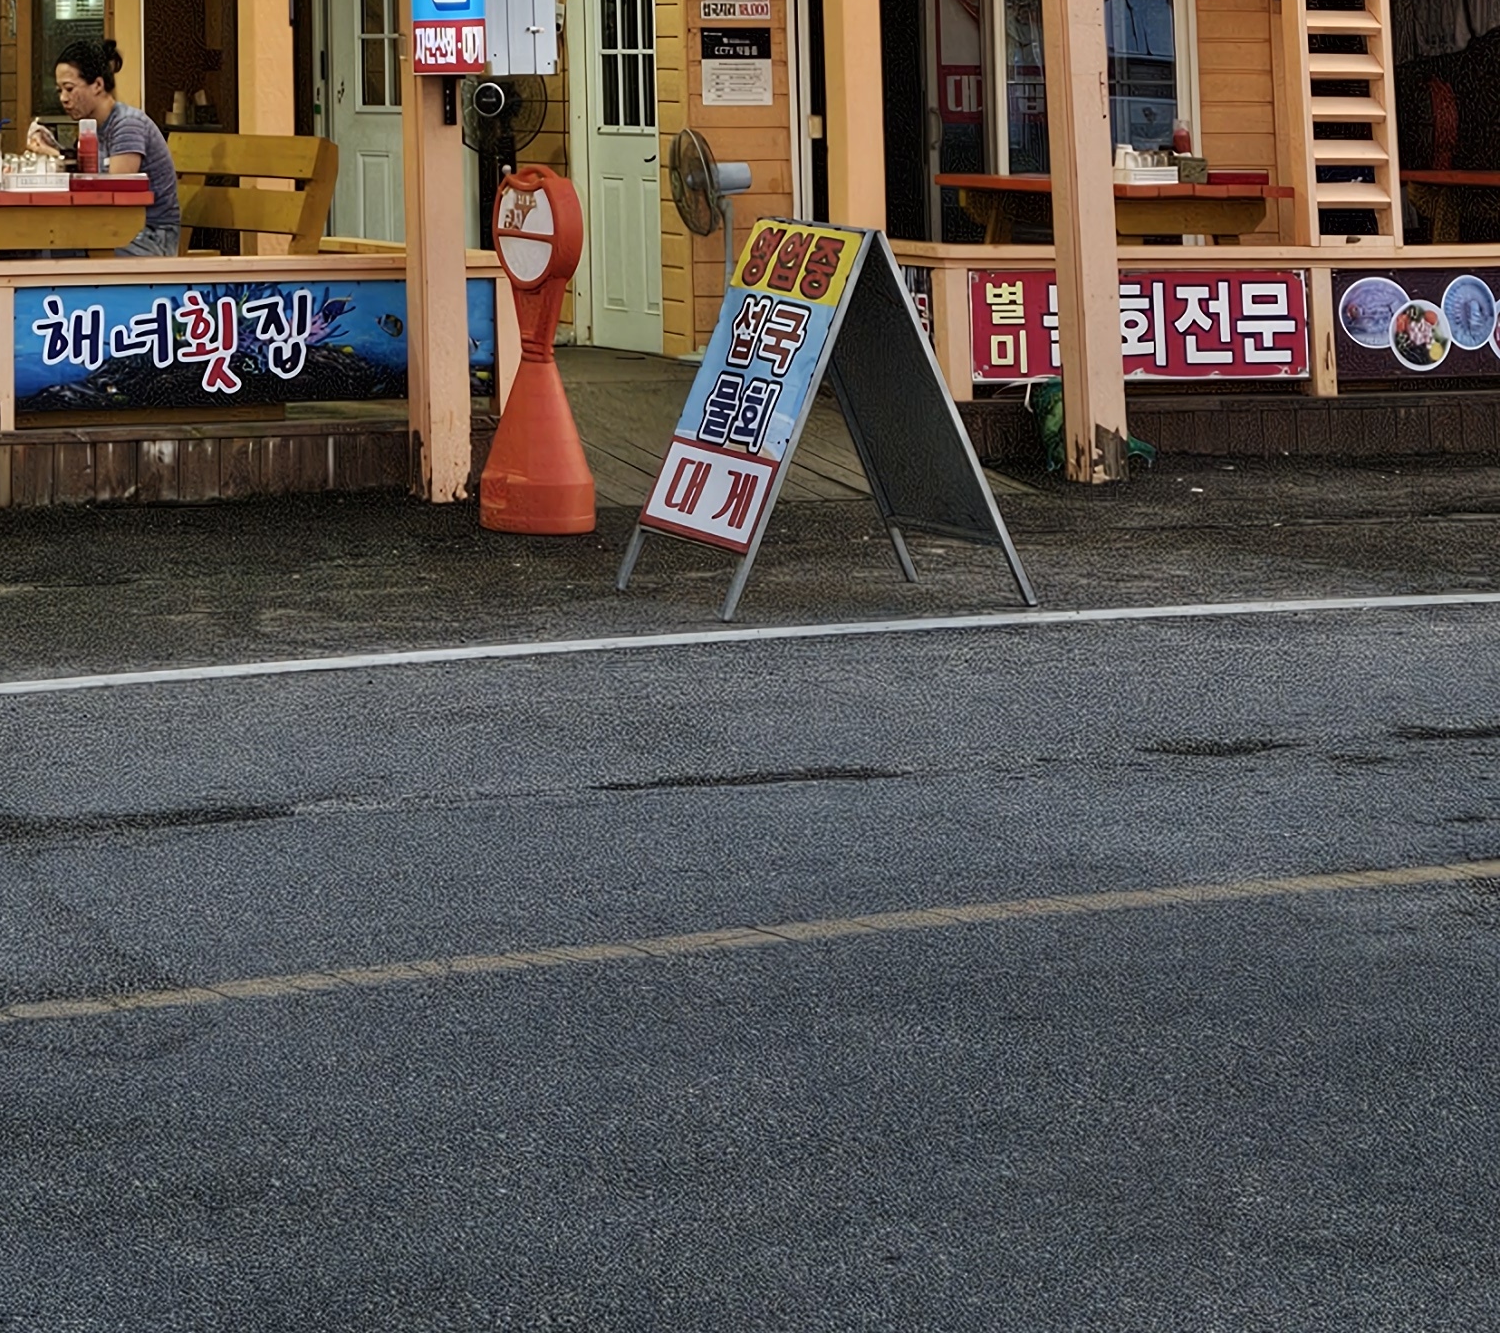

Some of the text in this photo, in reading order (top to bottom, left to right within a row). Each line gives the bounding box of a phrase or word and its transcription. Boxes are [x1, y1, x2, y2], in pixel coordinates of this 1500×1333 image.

[741, 227, 847, 301] 영업중
[33, 288, 312, 394] 해녀횟집
[727, 294, 811, 376] 섭국
[985, 280, 1028, 375] 별미
[1042, 280, 1296, 367] 회전문
[698, 371, 782, 454] 물회
[664, 456, 759, 530] 대게
